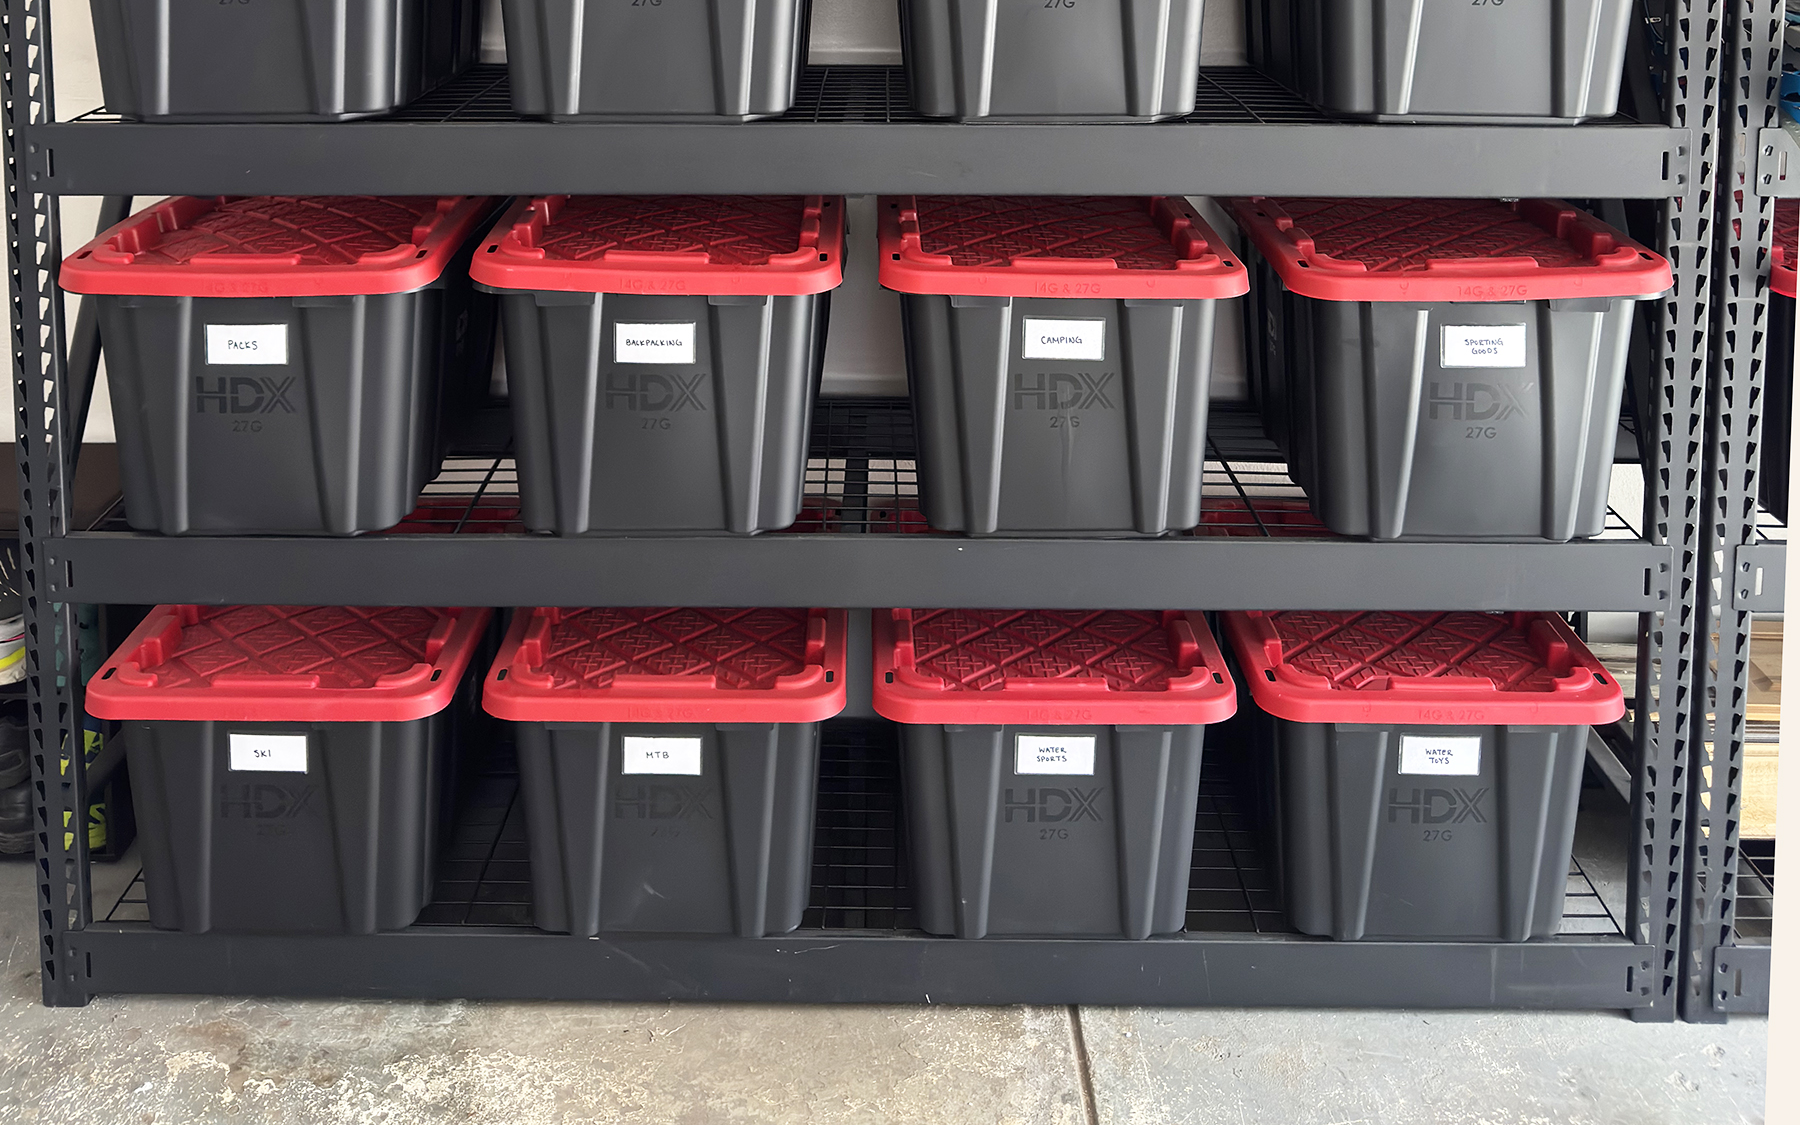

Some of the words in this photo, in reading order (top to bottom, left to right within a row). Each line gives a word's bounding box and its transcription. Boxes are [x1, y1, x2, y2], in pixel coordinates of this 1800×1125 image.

[619, 278, 643, 290] 14G
[659, 279, 687, 291] 27G
[1034, 282, 1058, 294] 14G
[1075, 282, 1102, 295] 27G
[1457, 285, 1484, 298] 14G
[1500, 284, 1529, 297] 27G
[227, 339, 258, 351] PACKS
[625, 338, 683, 347] BACKPACKING
[1040, 335, 1083, 345] CAMPING
[1464, 337, 1504, 346] SPORTING
[1471, 347, 1498, 355] GOODS
[195, 376, 297, 414] HDX
[604, 373, 707, 412] HDX
[1013, 372, 1116, 411] HDX
[1428, 382, 1536, 421] HDX
[232, 419, 263, 433] 27G
[641, 417, 672, 431] 27G
[1049, 416, 1081, 430] 27G
[1465, 426, 1497, 439] 27G
[253, 749, 272, 759] SKI
[645, 750, 670, 760] MTB
[1036, 755, 1068, 763] SPORTS
[1428, 756, 1450, 765] TOYS
[220, 783, 320, 820] HDX
[614, 784, 713, 820] HDX
[1004, 787, 1105, 824] HDX
[1387, 786, 1490, 824] HDX
[1039, 828, 1070, 841] 27G
[1422, 829, 1453, 843] 27G
